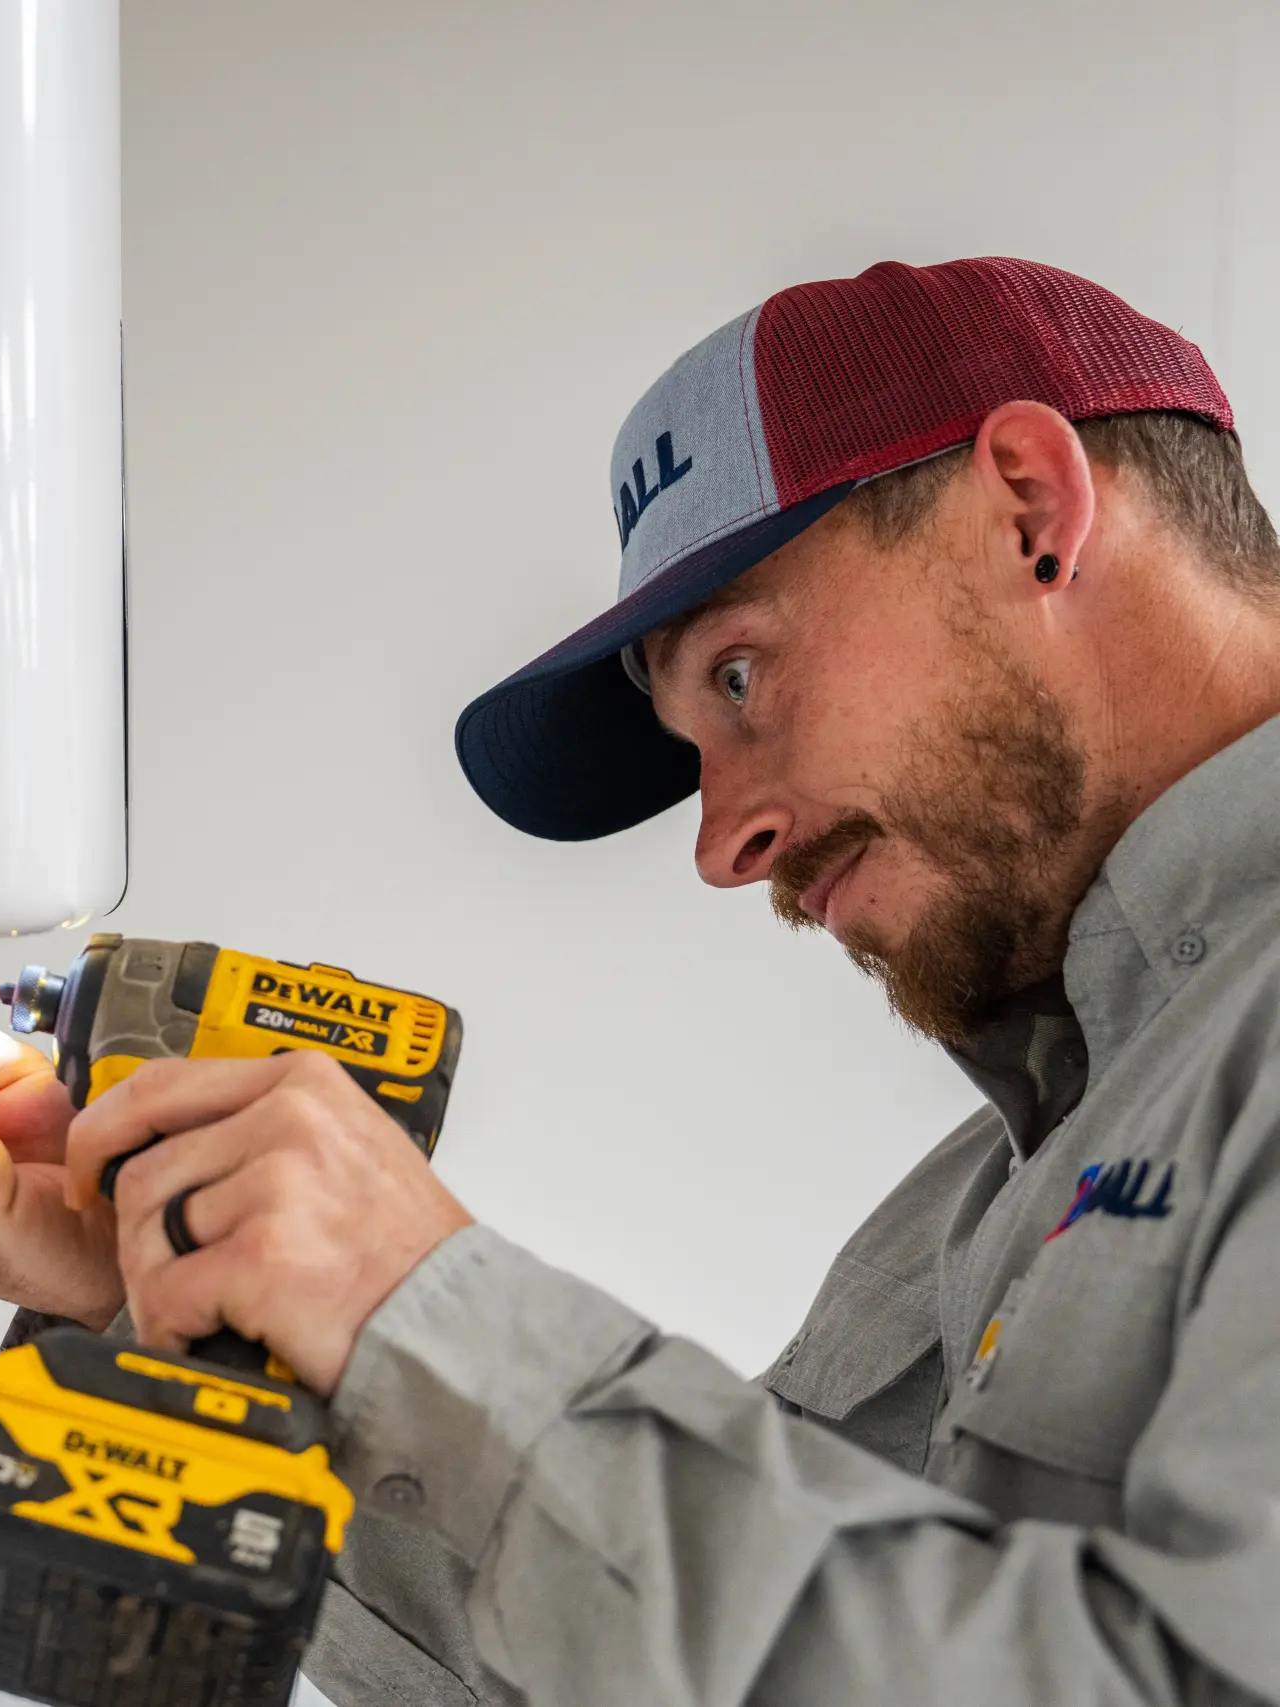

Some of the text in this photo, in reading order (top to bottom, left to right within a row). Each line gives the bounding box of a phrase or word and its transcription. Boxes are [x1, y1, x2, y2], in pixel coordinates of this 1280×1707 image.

[613, 430, 693, 555] ALL
[340, 1026, 376, 1053] XR
[9, 1464, 197, 1566] XR
